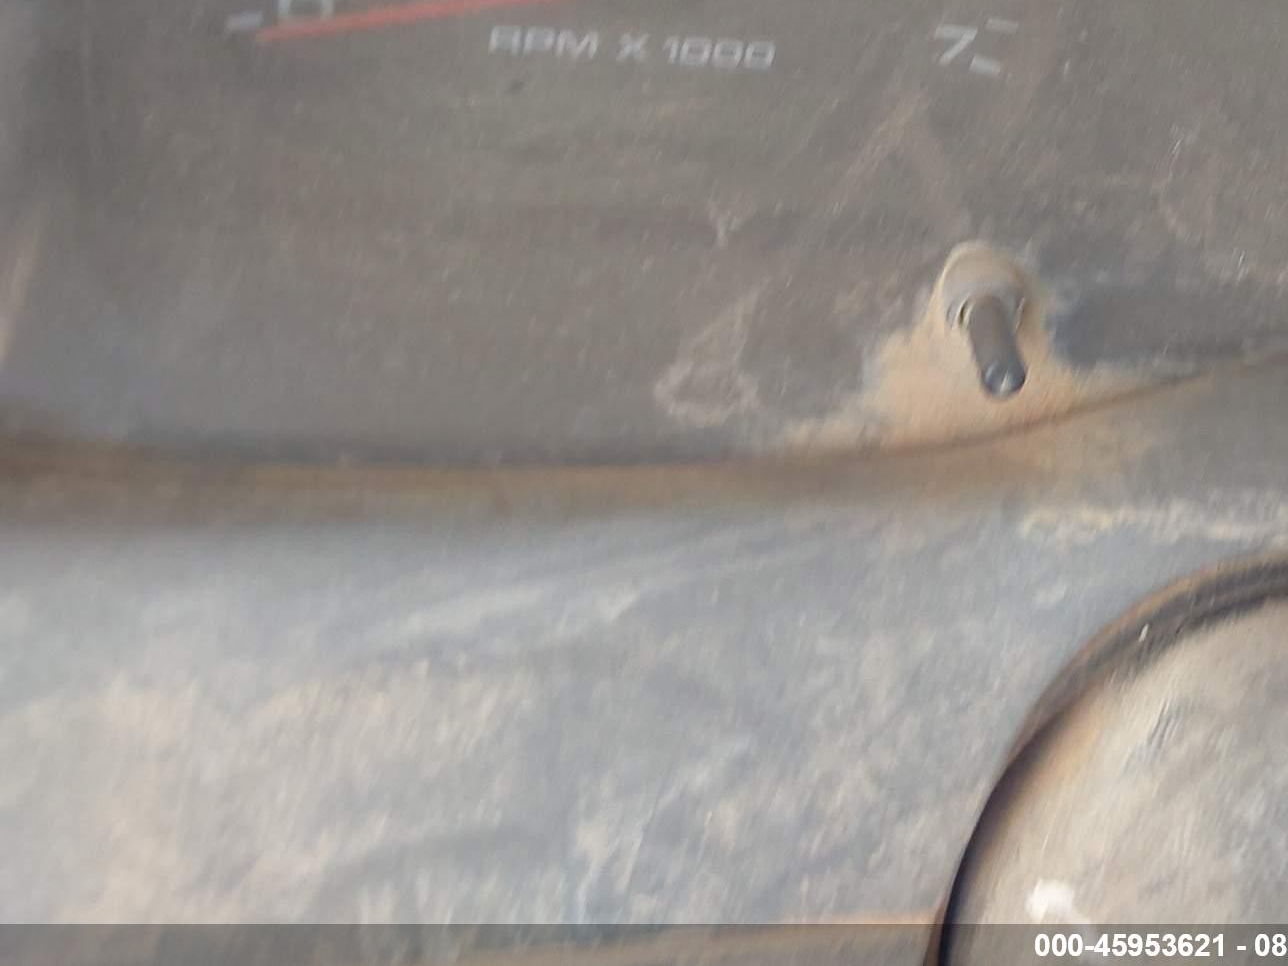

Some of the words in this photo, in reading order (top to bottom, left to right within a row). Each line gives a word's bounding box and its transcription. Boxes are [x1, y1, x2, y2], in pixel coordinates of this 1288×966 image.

[488, 24, 599, 59] RPM
[663, 35, 776, 71] 1000
[935, 24, 977, 66] 7
